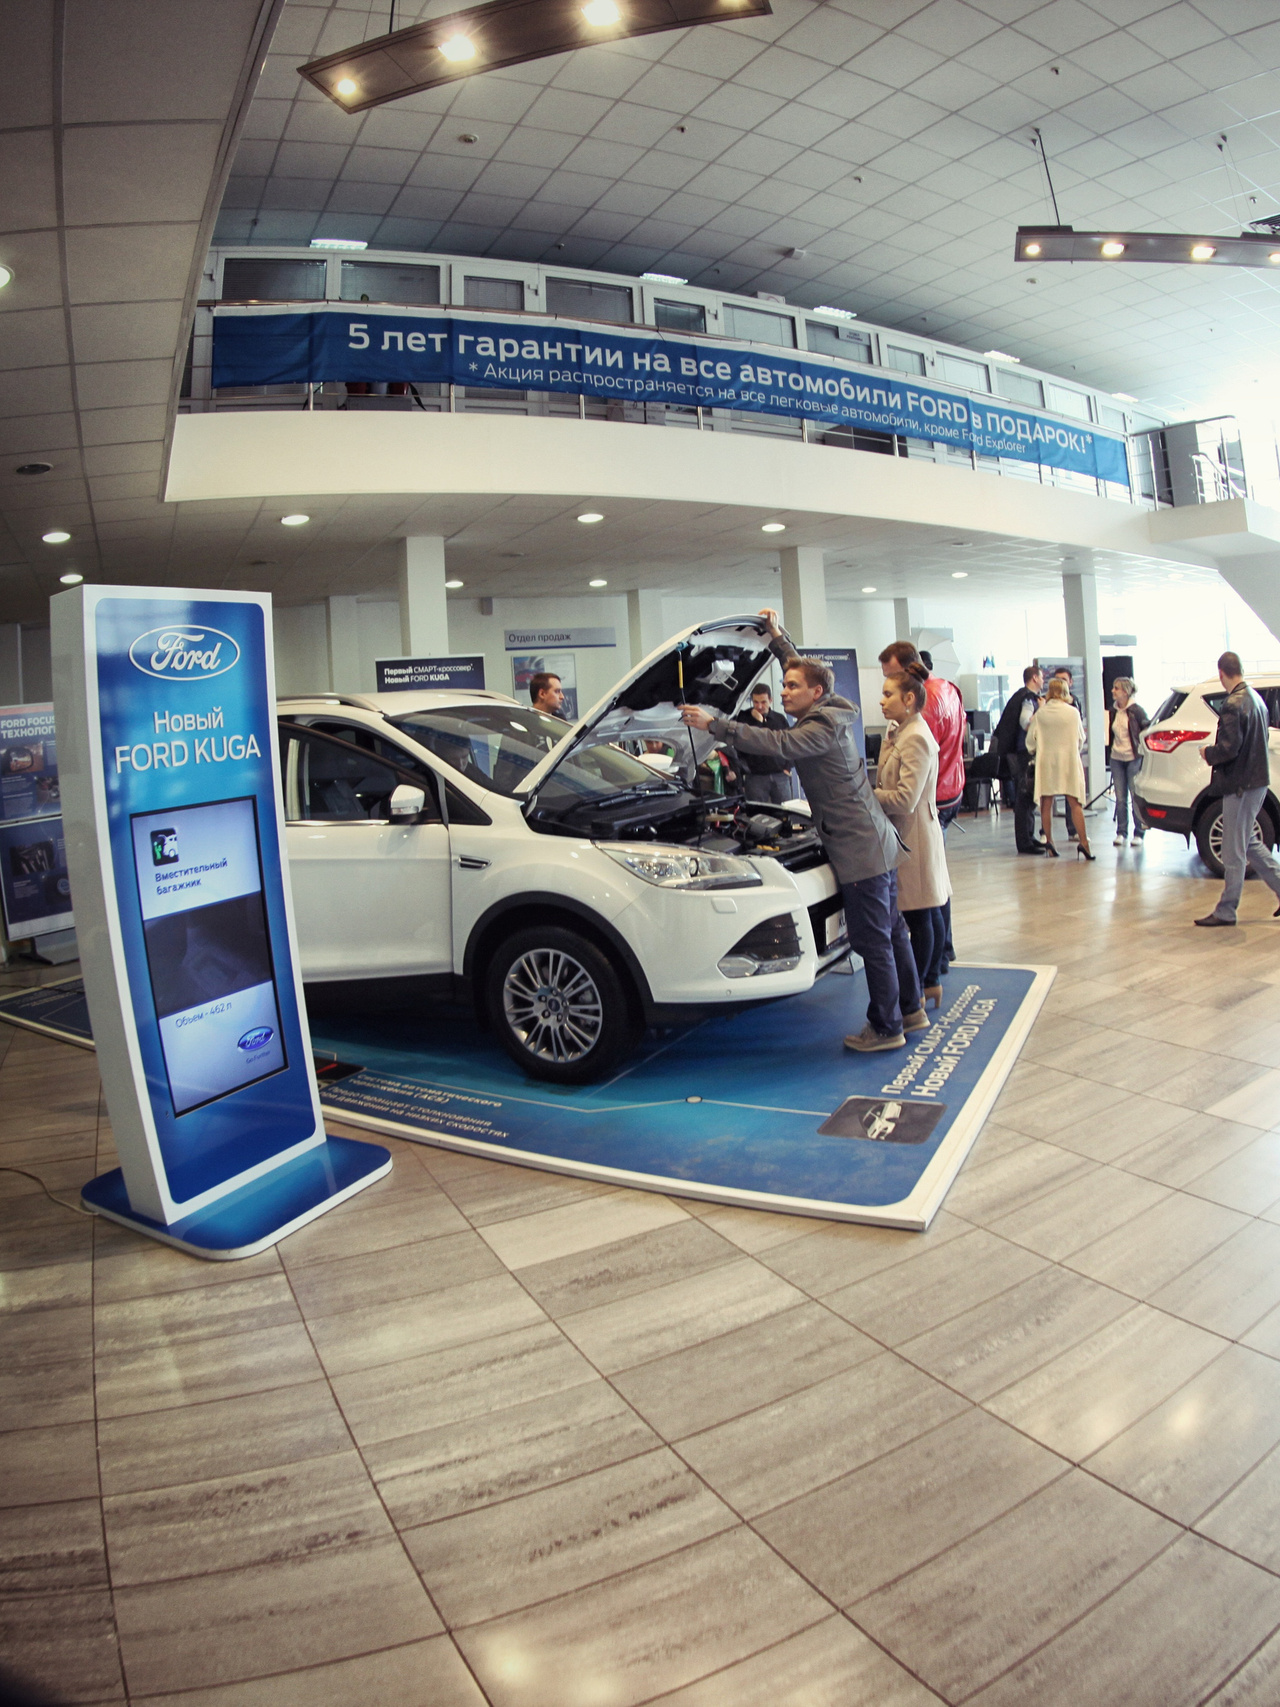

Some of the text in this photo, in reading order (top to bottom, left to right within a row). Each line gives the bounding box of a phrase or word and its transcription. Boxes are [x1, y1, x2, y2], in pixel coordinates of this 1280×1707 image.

[348, 323, 370, 350] 5
[381, 330, 448, 352] лет
[458, 334, 624, 369] гарантии
[633, 351, 671, 373] на
[680, 357, 732, 380] все
[740, 363, 901, 410] автомобили
[906, 391, 968, 423] FORD
[972, 411, 982, 429] в
[484, 362, 544, 382] Акция
[549, 369, 714, 398] распространяется
[718, 387, 736, 400] на
[741, 390, 765, 404] все
[770, 394, 838, 415] легковые
[841, 404, 922, 432] автомобили,
[924, 421, 959, 440] кроме
[986, 437, 1026, 453] Explorer
[508, 631, 571, 643] Отдел продаж
[151, 632, 222, 671] Ford
[384, 666, 413, 676] Первый
[385, 673, 450, 684] Новый FORD KUGA
[1, 718, 26, 729] FORD
[1, 725, 56, 739] ТЕХНОЛОГ
[153, 706, 224, 734] Новый
[115, 734, 261, 773] FORD KUGA
[155, 857, 228, 882] Вместительный
[156, 878, 202, 895] багажник
[175, 1011, 204, 1028] Объем
[210, 1003, 226, 1015] 462
[911, 998, 998, 1097] Новый FORD KUGA
[357, 1074, 401, 1088] Система
[881, 1054, 928, 1094] Первый
